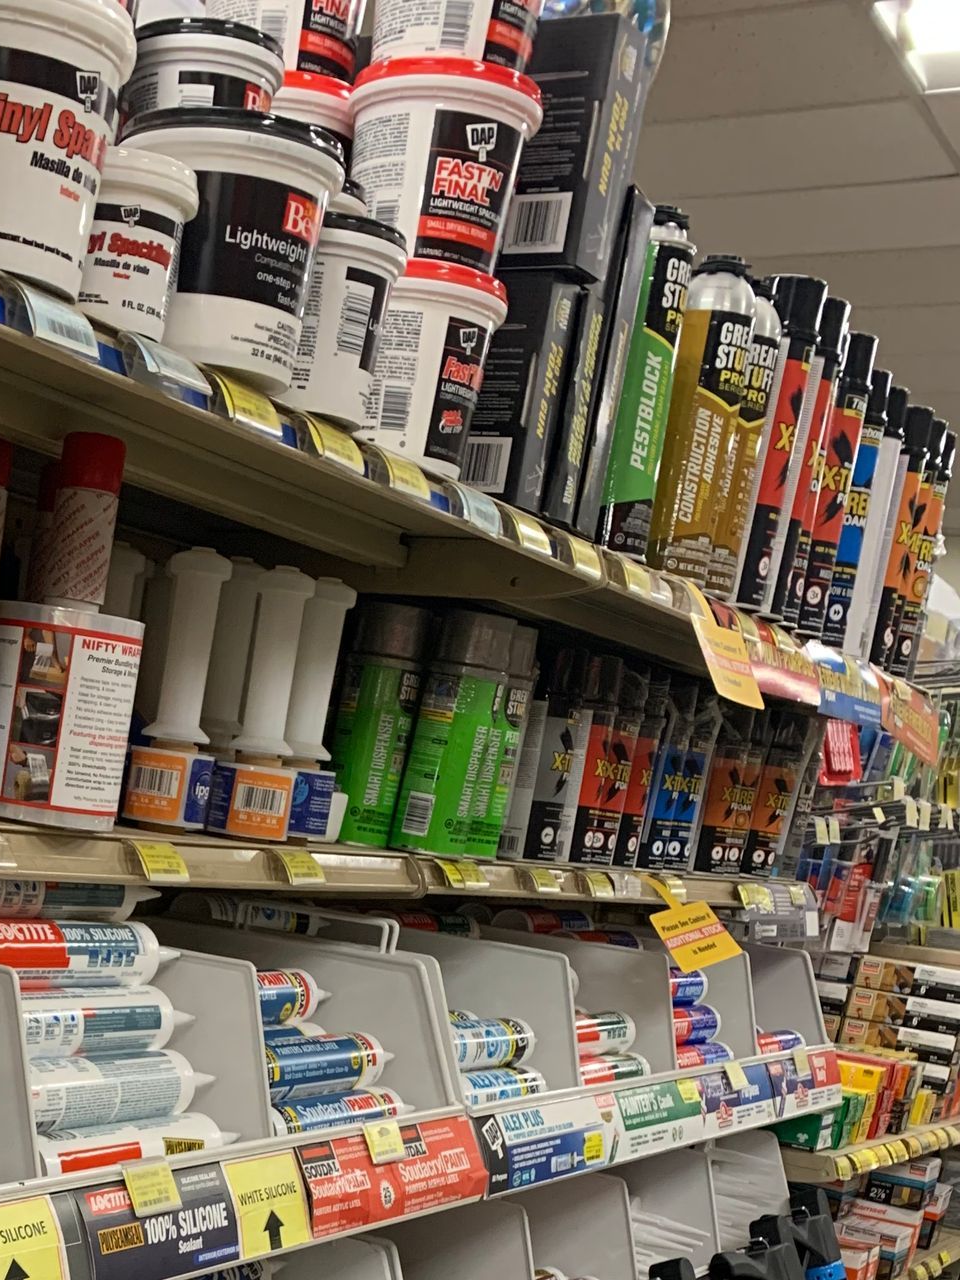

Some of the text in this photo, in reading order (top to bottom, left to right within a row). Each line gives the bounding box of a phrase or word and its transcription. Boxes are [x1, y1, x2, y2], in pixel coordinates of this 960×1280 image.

[471, 127, 495, 145] DAP
[30, 151, 83, 184] Masilla de
[437, 156, 503, 189] FAST'N
[432, 178, 491, 205] FINAL
[430, 197, 477, 217] LIGHTWEIGHT
[224, 223, 308, 264] Lightweight
[256, 271, 292, 291] one-step
[462, 329, 478, 345] DAP
[629, 349, 663, 471] PESTBLOCK
[702, 413, 725, 483] ADHESIVE
[678, 406, 711, 525] CONSTRUCTION
[81, 639, 117, 655] NIFTY
[87, 654, 114, 667] Premier
[363, 714, 395, 806] SMART DISPENSER
[466, 726, 488, 781] DISPENSER
[63, 927, 90, 943] 100%
[91, 928, 134, 941] SILICONE
[661, 924, 679, 932] Please
[698, 943, 717, 953] Needed
[260, 972, 289, 987] PAINT
[301, 1095, 376, 1123] Soudacryl PAINT
[501, 1109, 545, 1133] ALEX PLUS
[304, 1162, 340, 1179] SOUDAL
[443, 1149, 471, 1170] PAINT
[238, 1181, 297, 1207] WHITE SILICONE
[1, 1220, 47, 1246] SILICONE
[144, 1203, 229, 1245] 100% SILICONE
